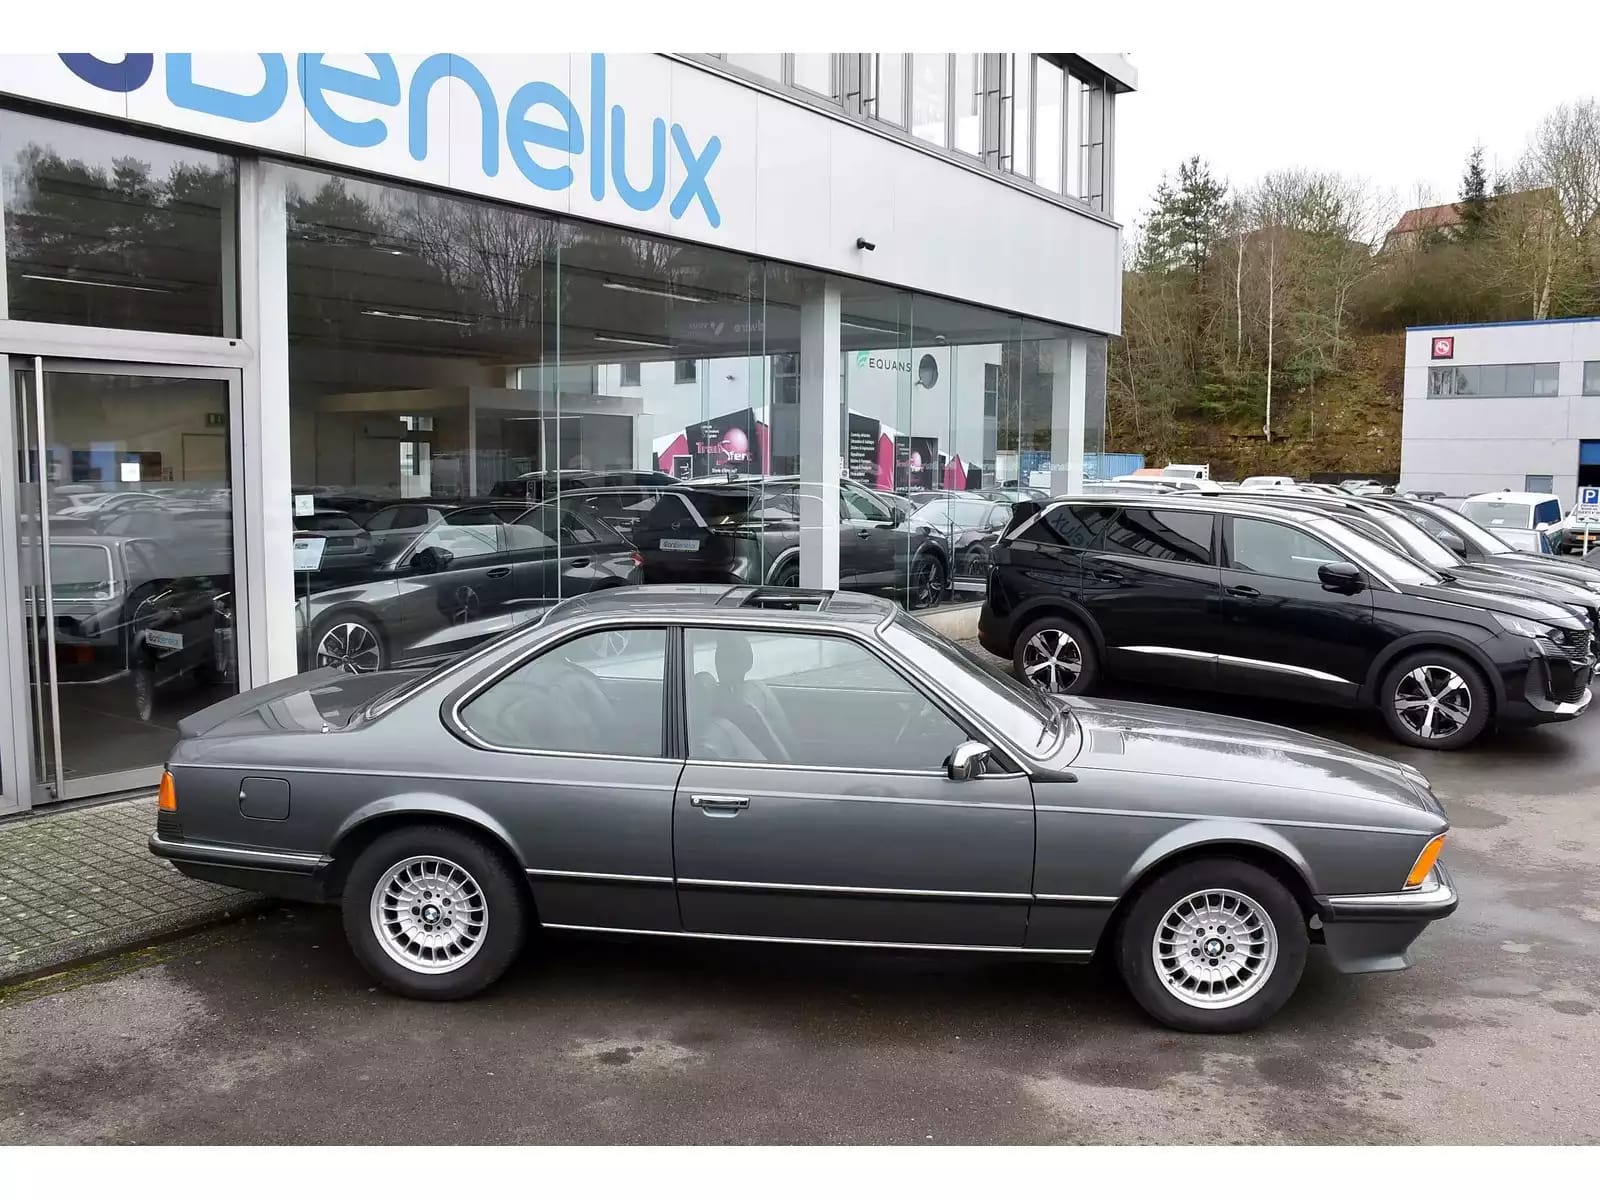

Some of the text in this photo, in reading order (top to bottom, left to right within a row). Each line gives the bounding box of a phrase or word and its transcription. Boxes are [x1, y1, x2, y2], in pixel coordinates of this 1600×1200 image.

[58, 53, 722, 229] enelux
[869, 357, 912, 373] EQUANS
[1585, 489, 1596, 503] P
